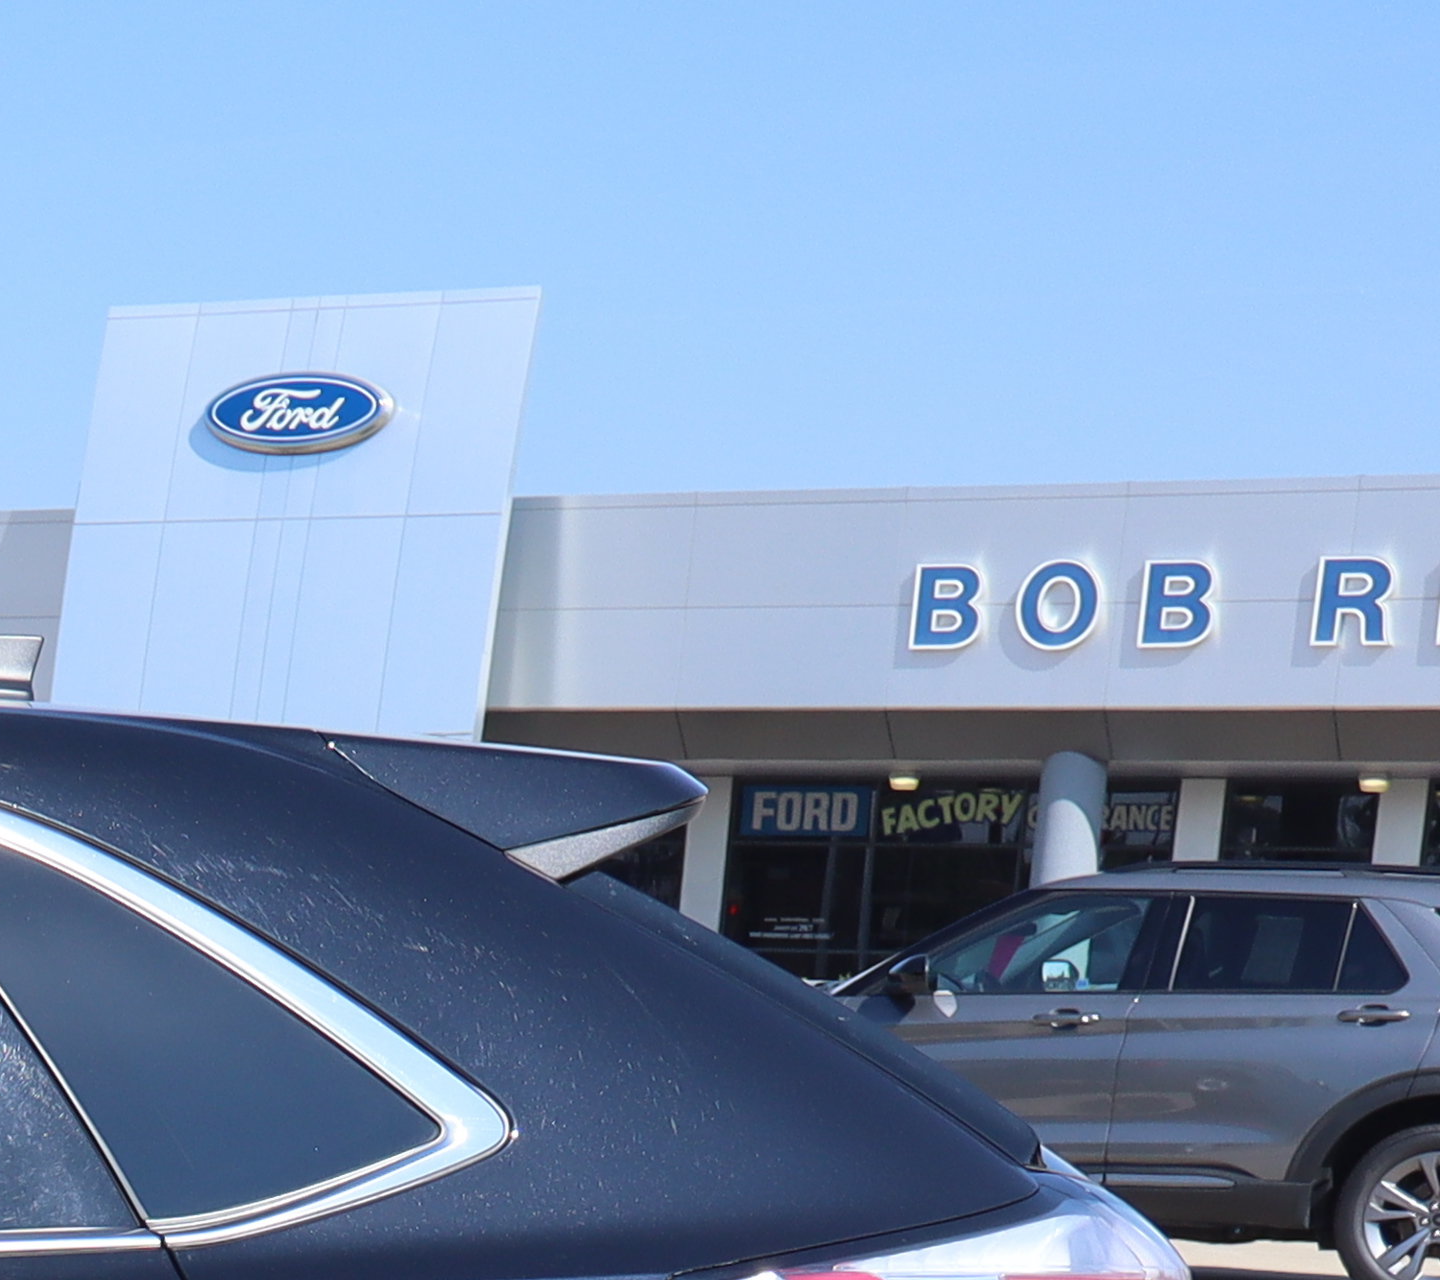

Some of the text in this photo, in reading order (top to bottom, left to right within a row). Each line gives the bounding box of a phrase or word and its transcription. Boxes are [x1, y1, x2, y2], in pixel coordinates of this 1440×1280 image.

[239, 387, 345, 431] Ford
[909, 558, 1217, 651] BOB
[751, 791, 859, 832] FORD
[882, 789, 1023, 836] FACTORY
